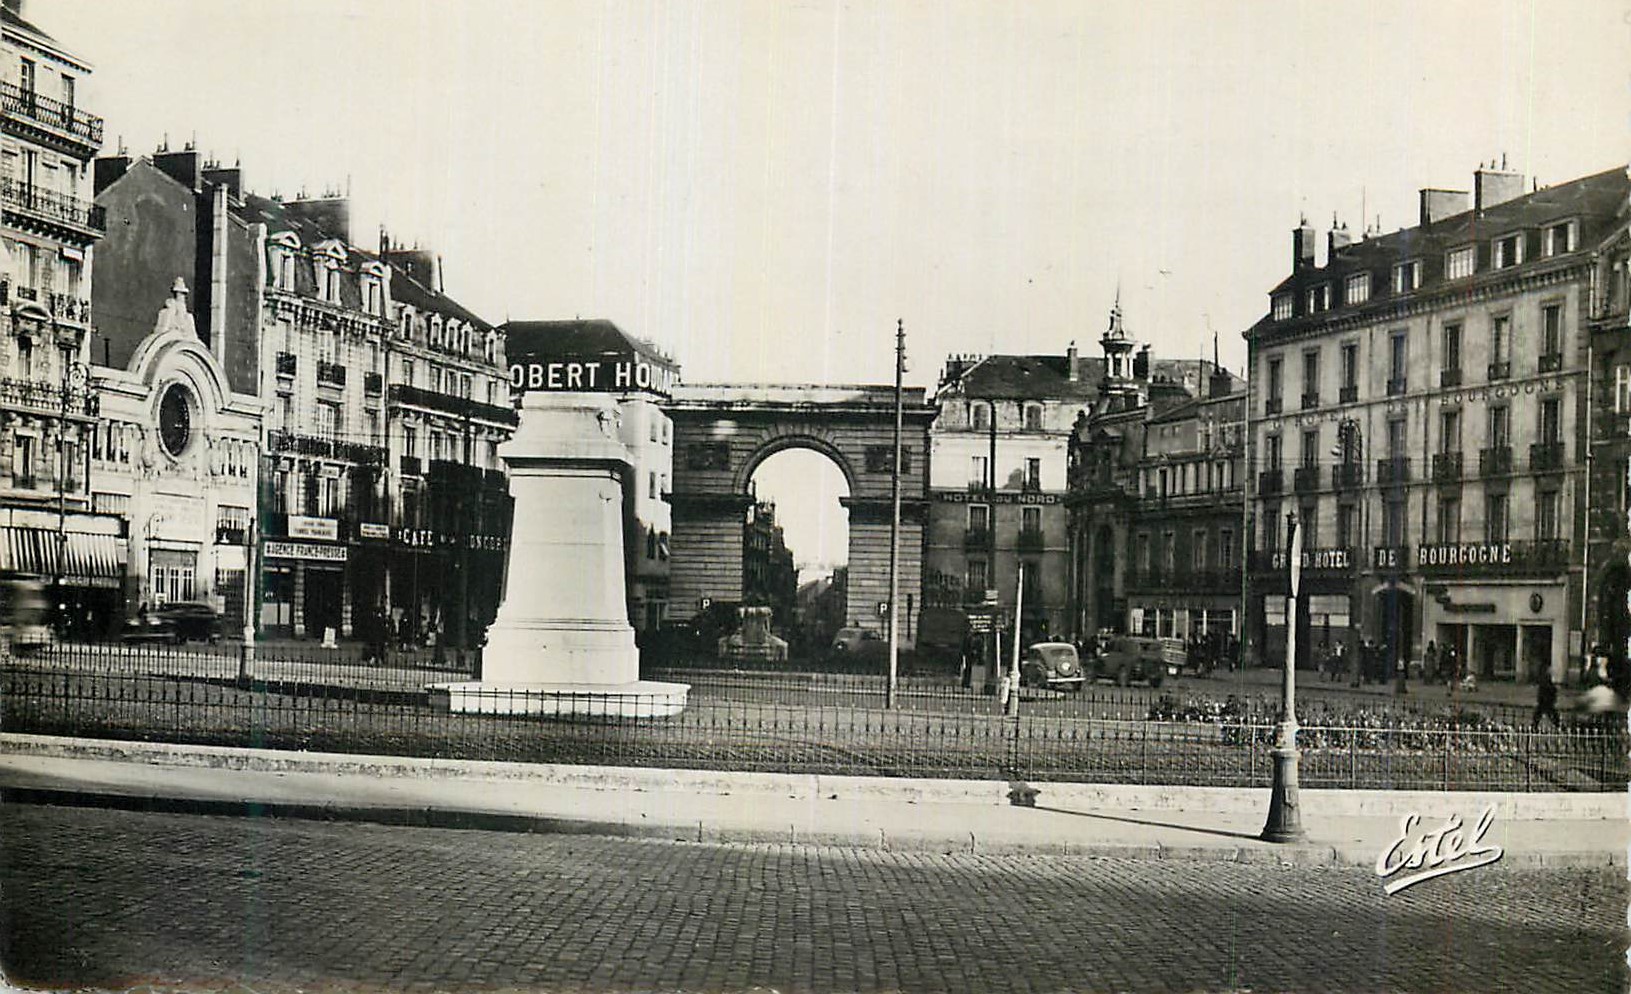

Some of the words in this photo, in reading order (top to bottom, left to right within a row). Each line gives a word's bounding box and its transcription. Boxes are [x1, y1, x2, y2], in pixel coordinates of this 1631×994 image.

[1272, 553, 1309, 568] GRD
[1315, 551, 1350, 568] HOTEL
[1379, 549, 1396, 567] DE
[1420, 543, 1511, 565] BOURGOGNE
